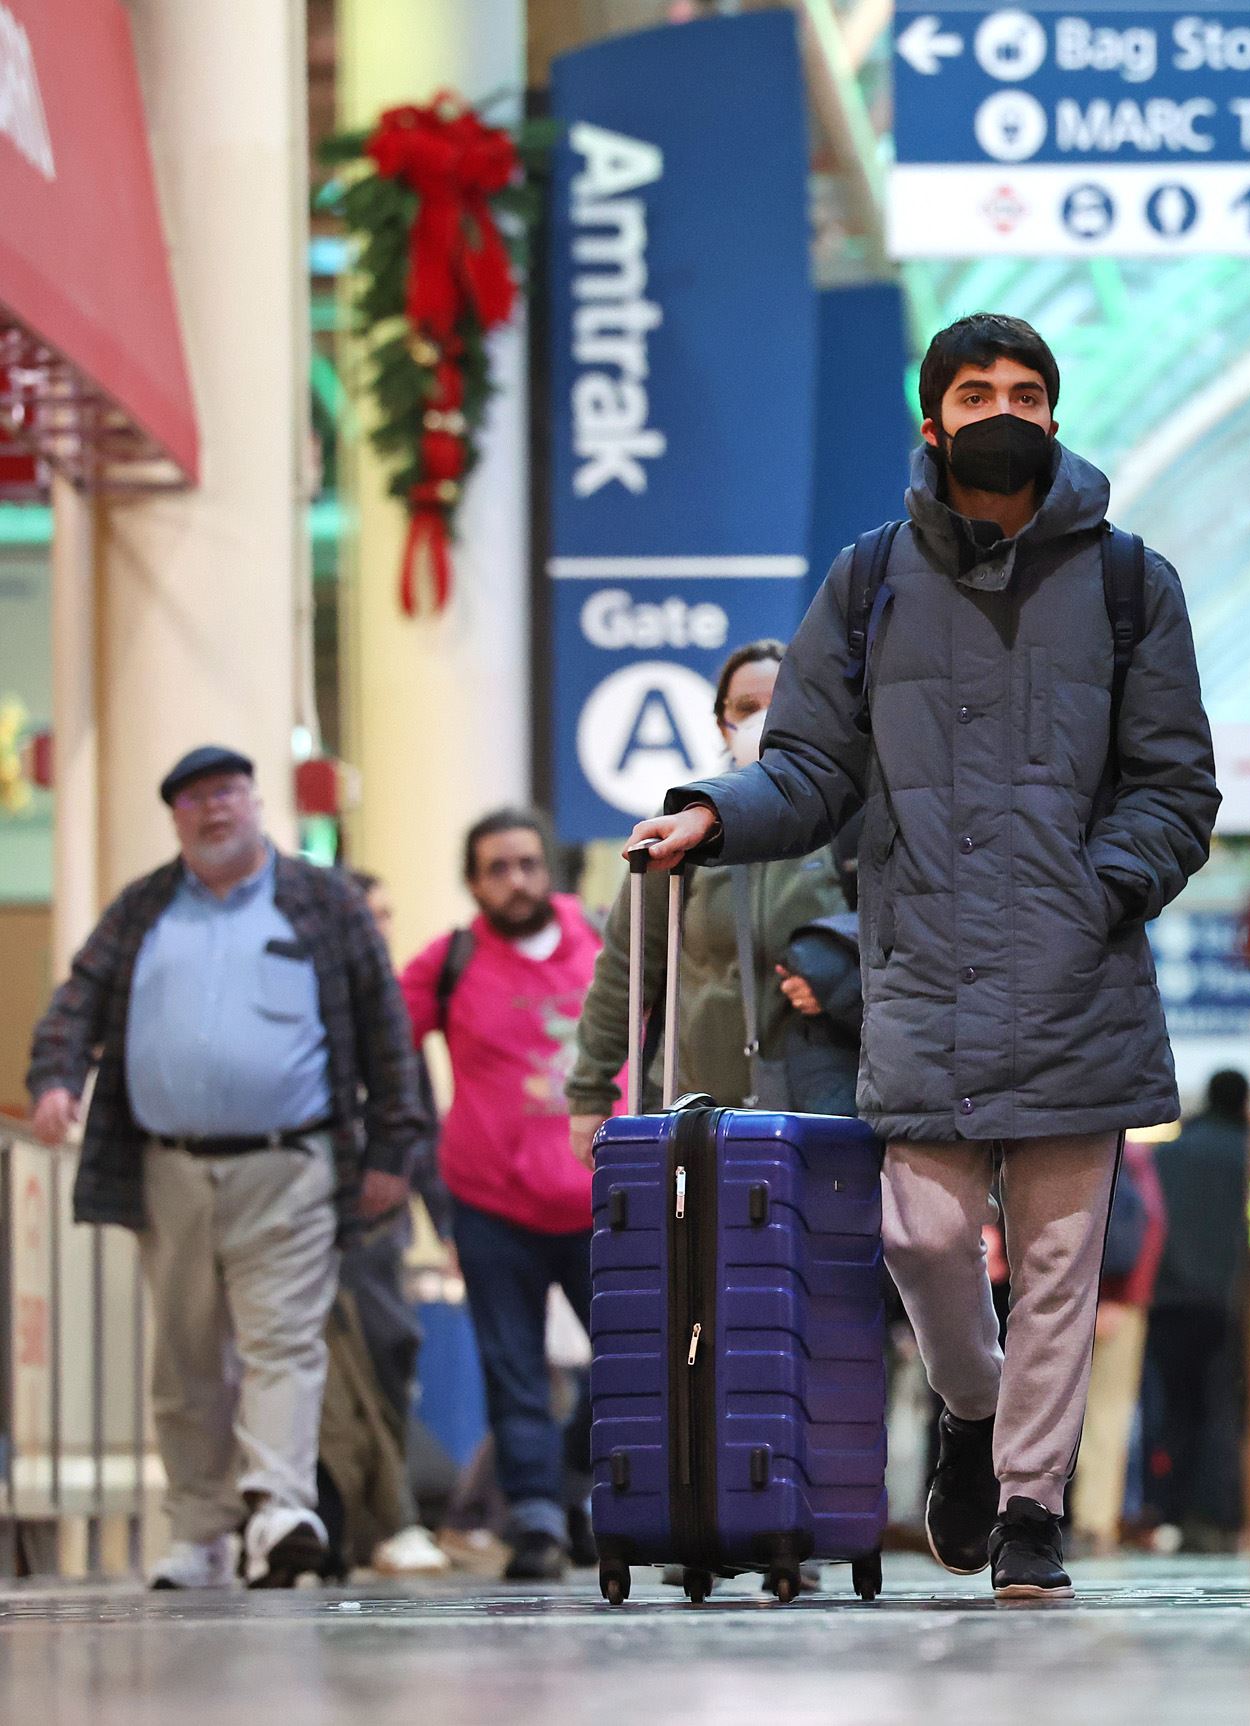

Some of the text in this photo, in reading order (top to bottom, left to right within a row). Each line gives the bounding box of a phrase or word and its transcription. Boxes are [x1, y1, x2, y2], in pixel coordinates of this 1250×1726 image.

[1055, 17, 1157, 82] Bag
[1056, 98, 1214, 152] MARC
[570, 122, 666, 497] Amtrak
[580, 589, 728, 650] Gate
[616, 688, 694, 773] A
